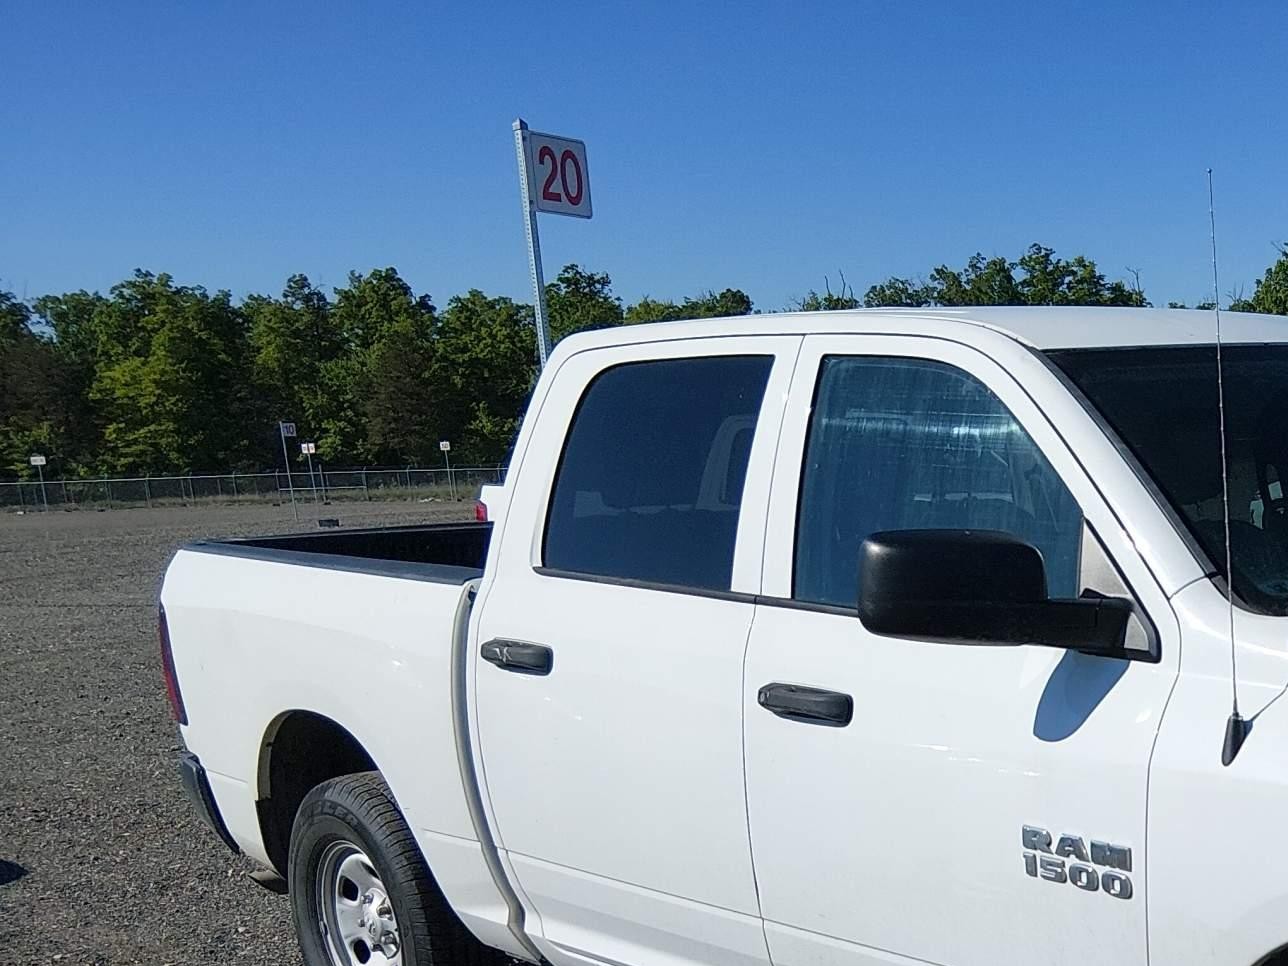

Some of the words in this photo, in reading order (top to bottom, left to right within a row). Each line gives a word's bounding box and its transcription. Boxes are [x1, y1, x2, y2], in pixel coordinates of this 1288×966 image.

[538, 145, 583, 206] 20
[1022, 824, 1132, 872] RAM
[1023, 851, 1133, 900] 1500
